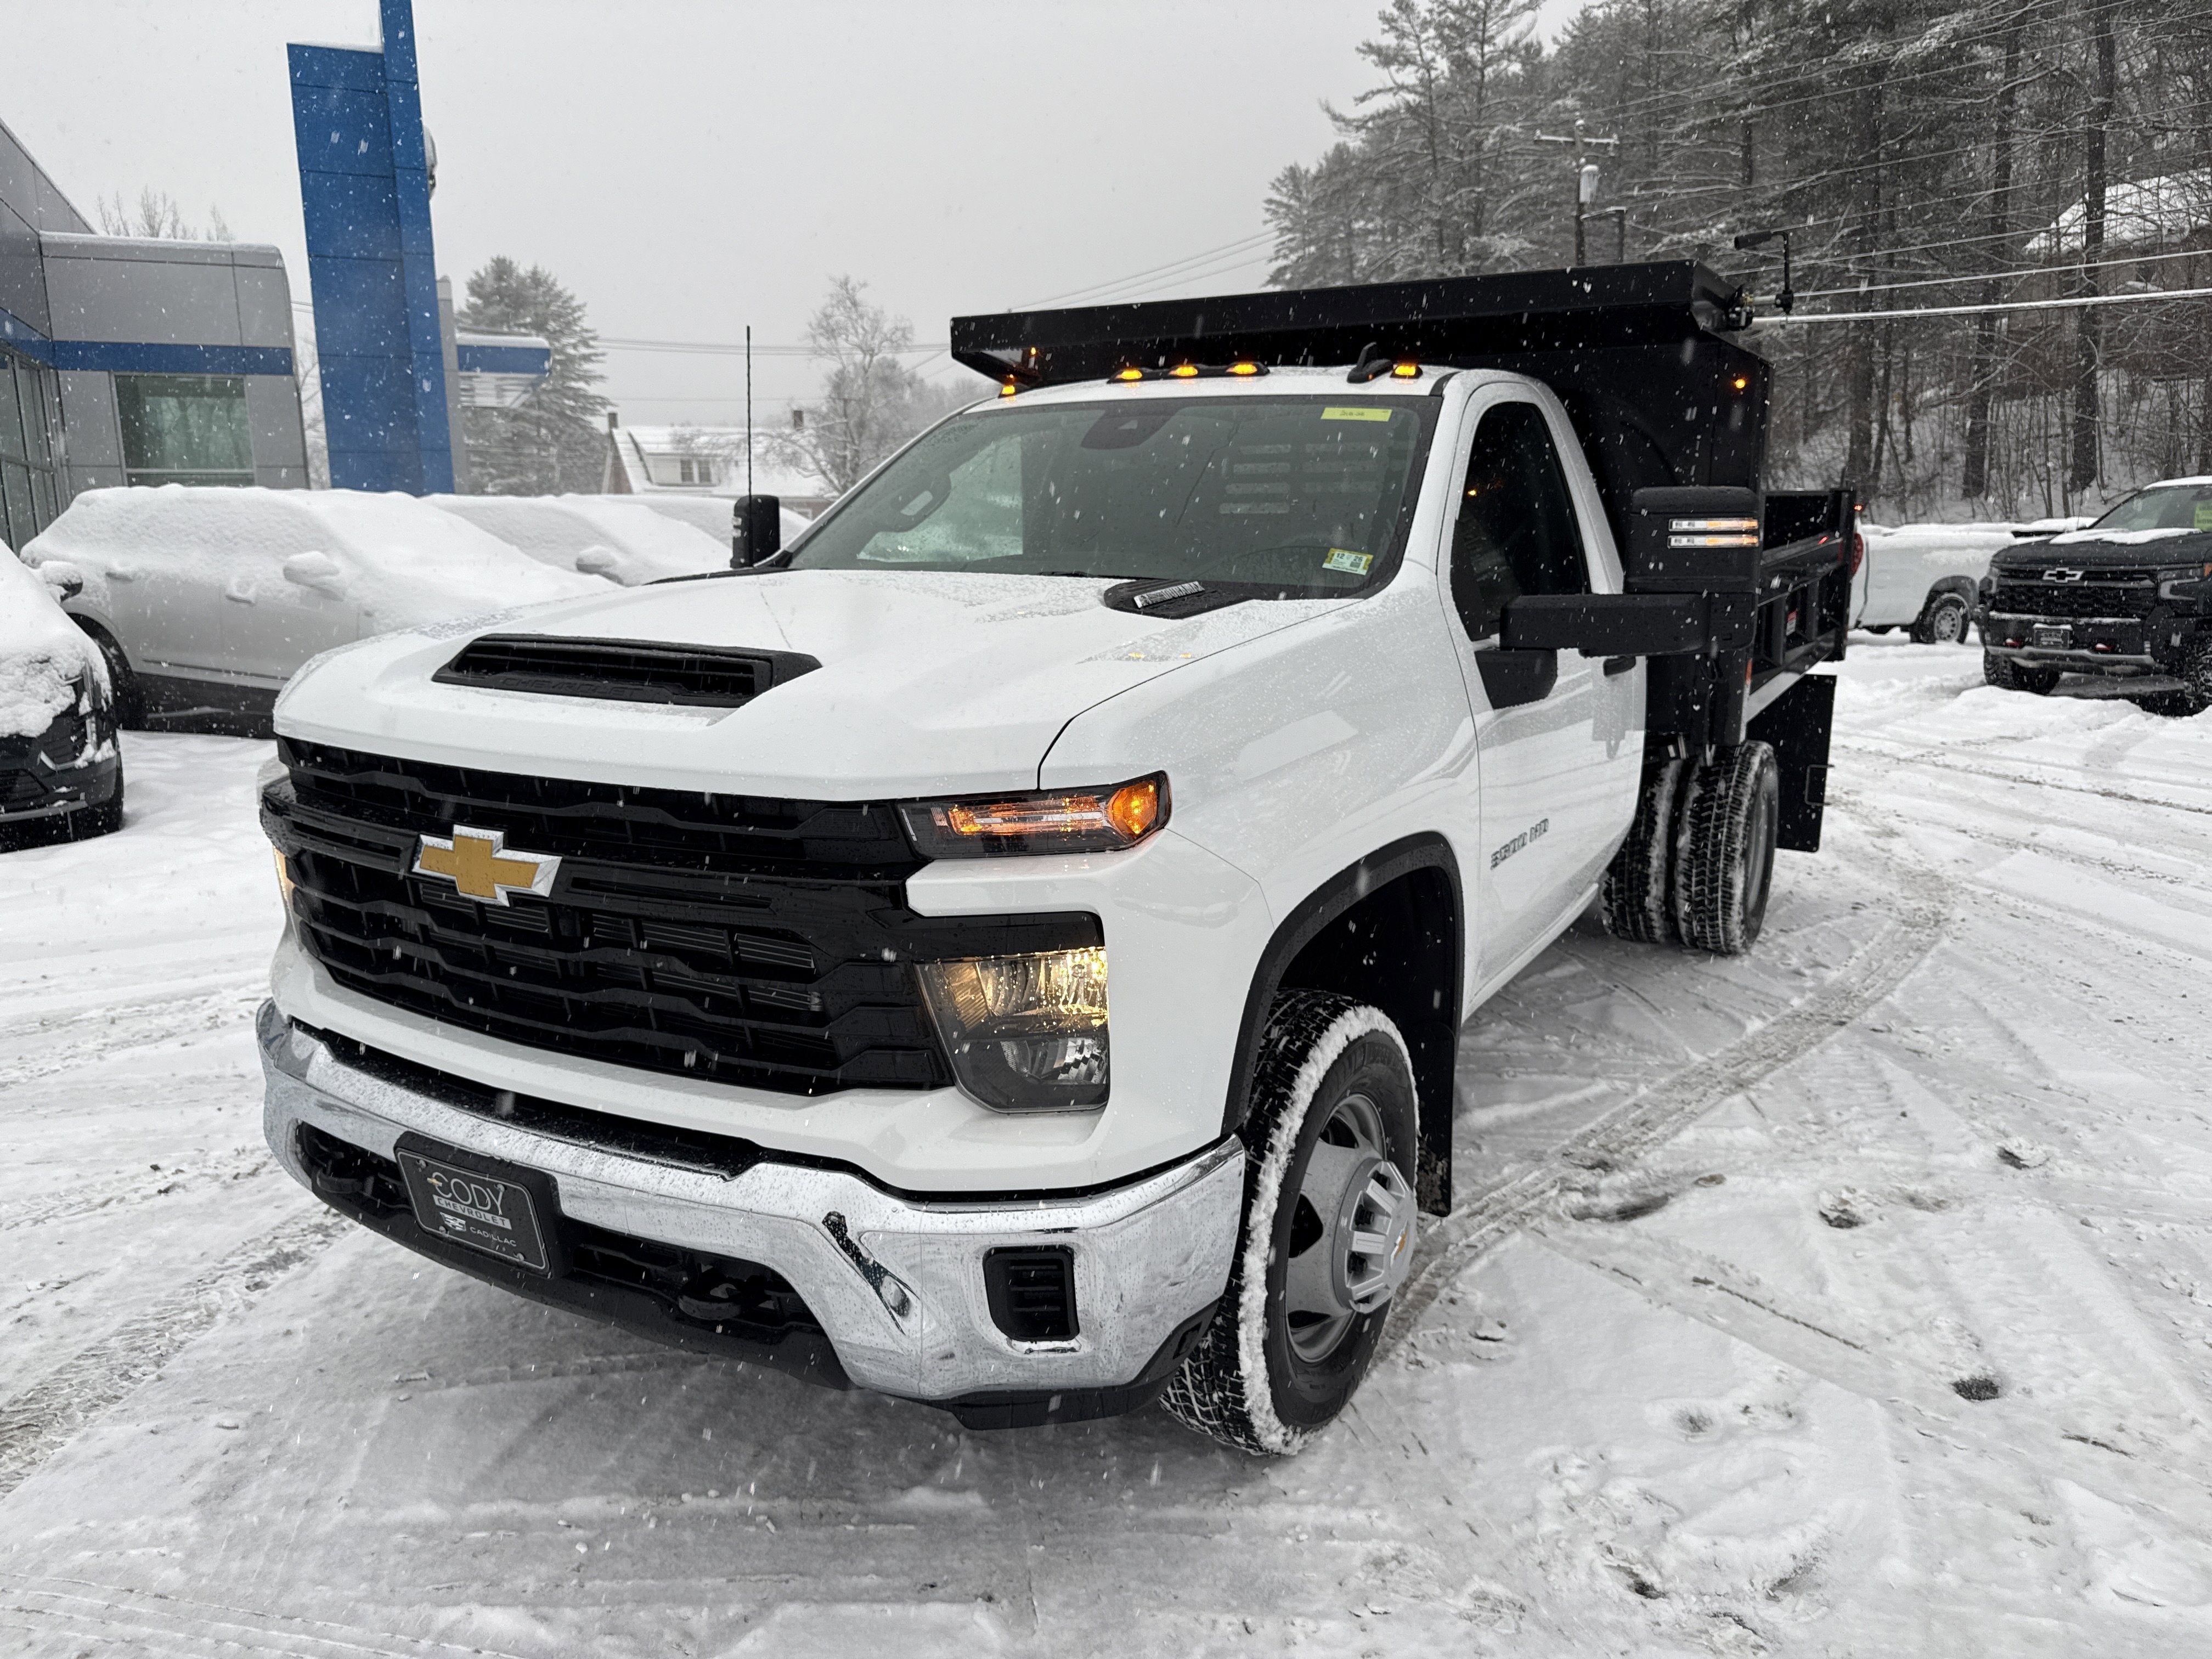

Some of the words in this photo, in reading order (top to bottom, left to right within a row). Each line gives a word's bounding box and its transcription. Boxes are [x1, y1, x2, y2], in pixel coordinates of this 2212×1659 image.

[503, 677, 644, 697] CHEVROLET
[432, 1171, 504, 1215] CODY
[438, 1198, 506, 1226] CHEVROLET
[470, 1226, 517, 1246] CADILLAC
